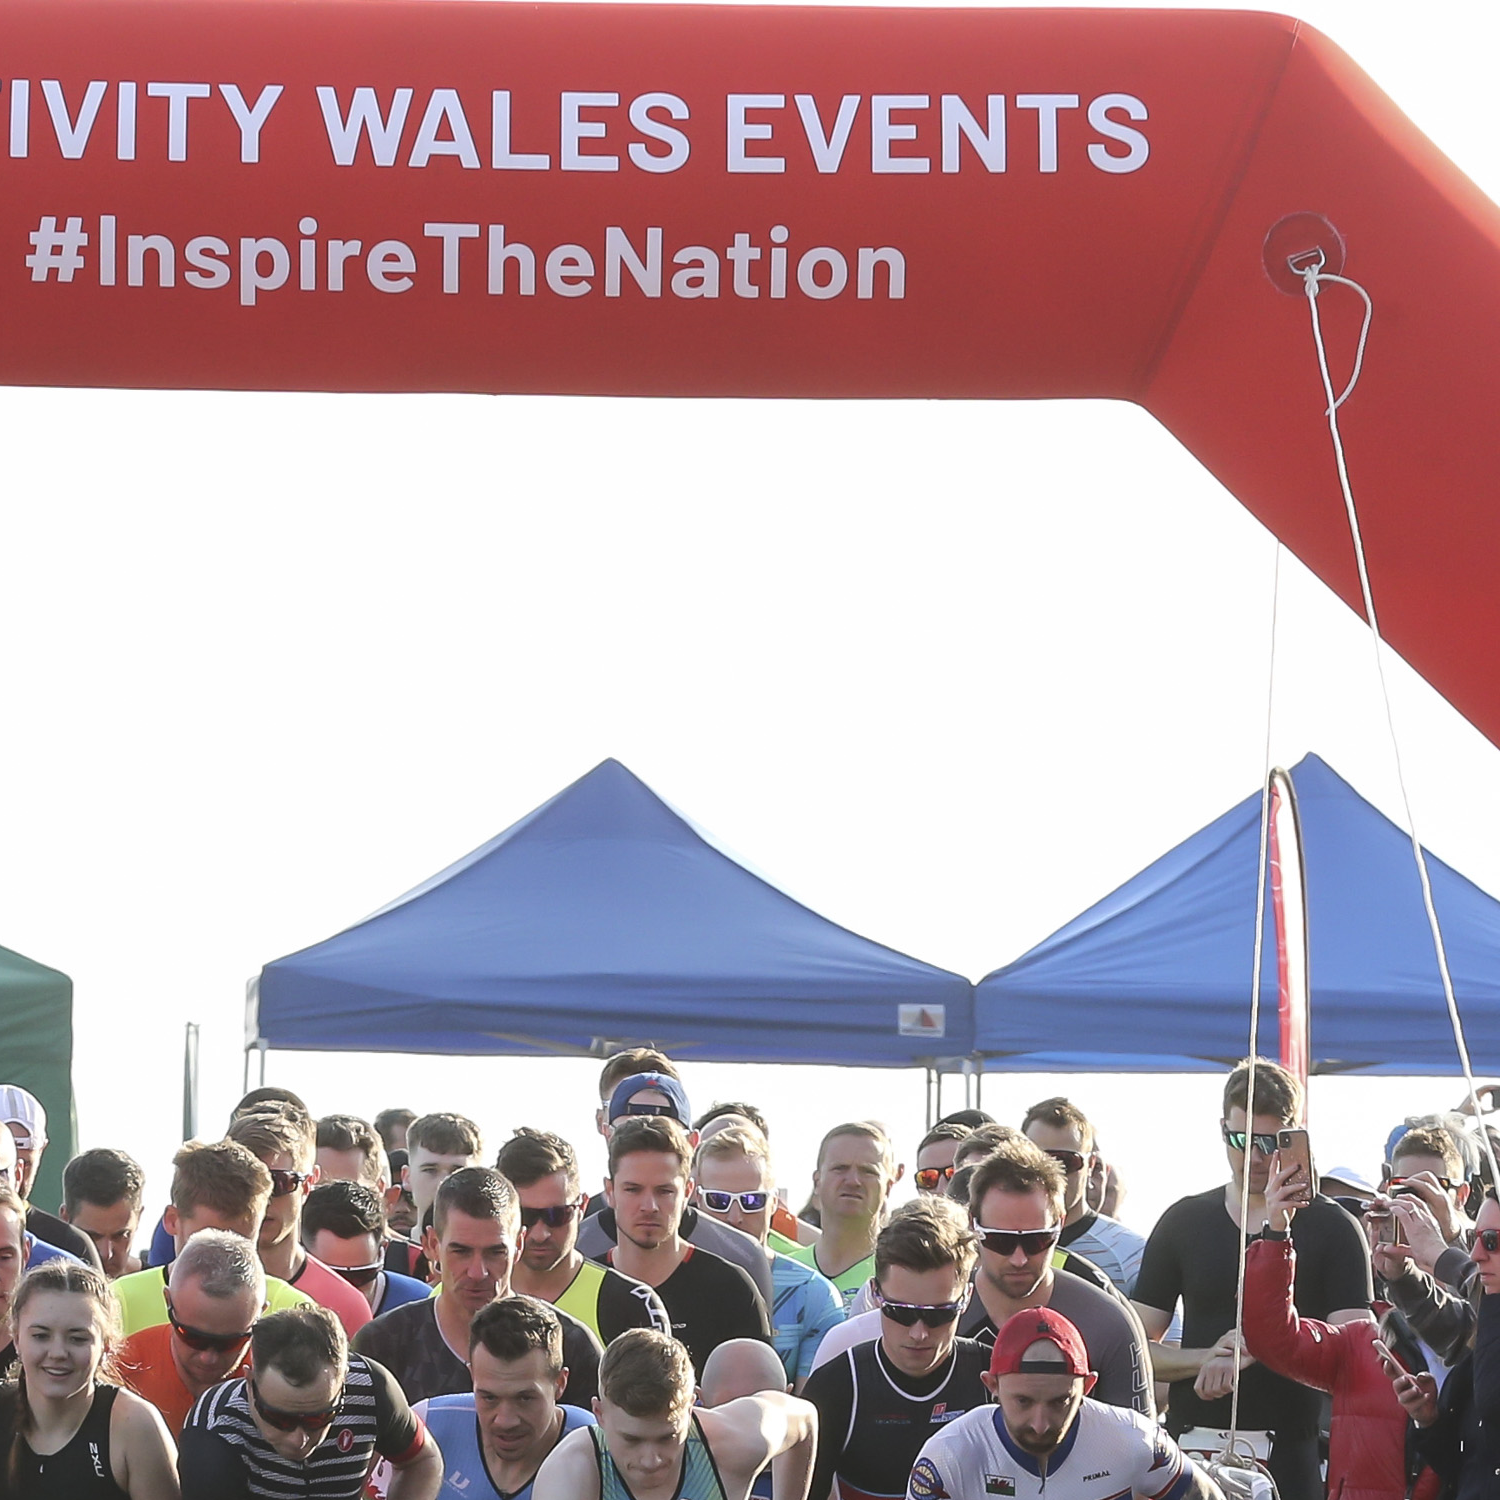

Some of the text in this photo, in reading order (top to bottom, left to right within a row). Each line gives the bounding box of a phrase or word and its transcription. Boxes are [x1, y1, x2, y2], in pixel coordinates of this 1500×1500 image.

[316, 87, 689, 172] WALES
[728, 94, 1148, 173] EVENTS
[26, 216, 905, 305] #InspireTheNation
